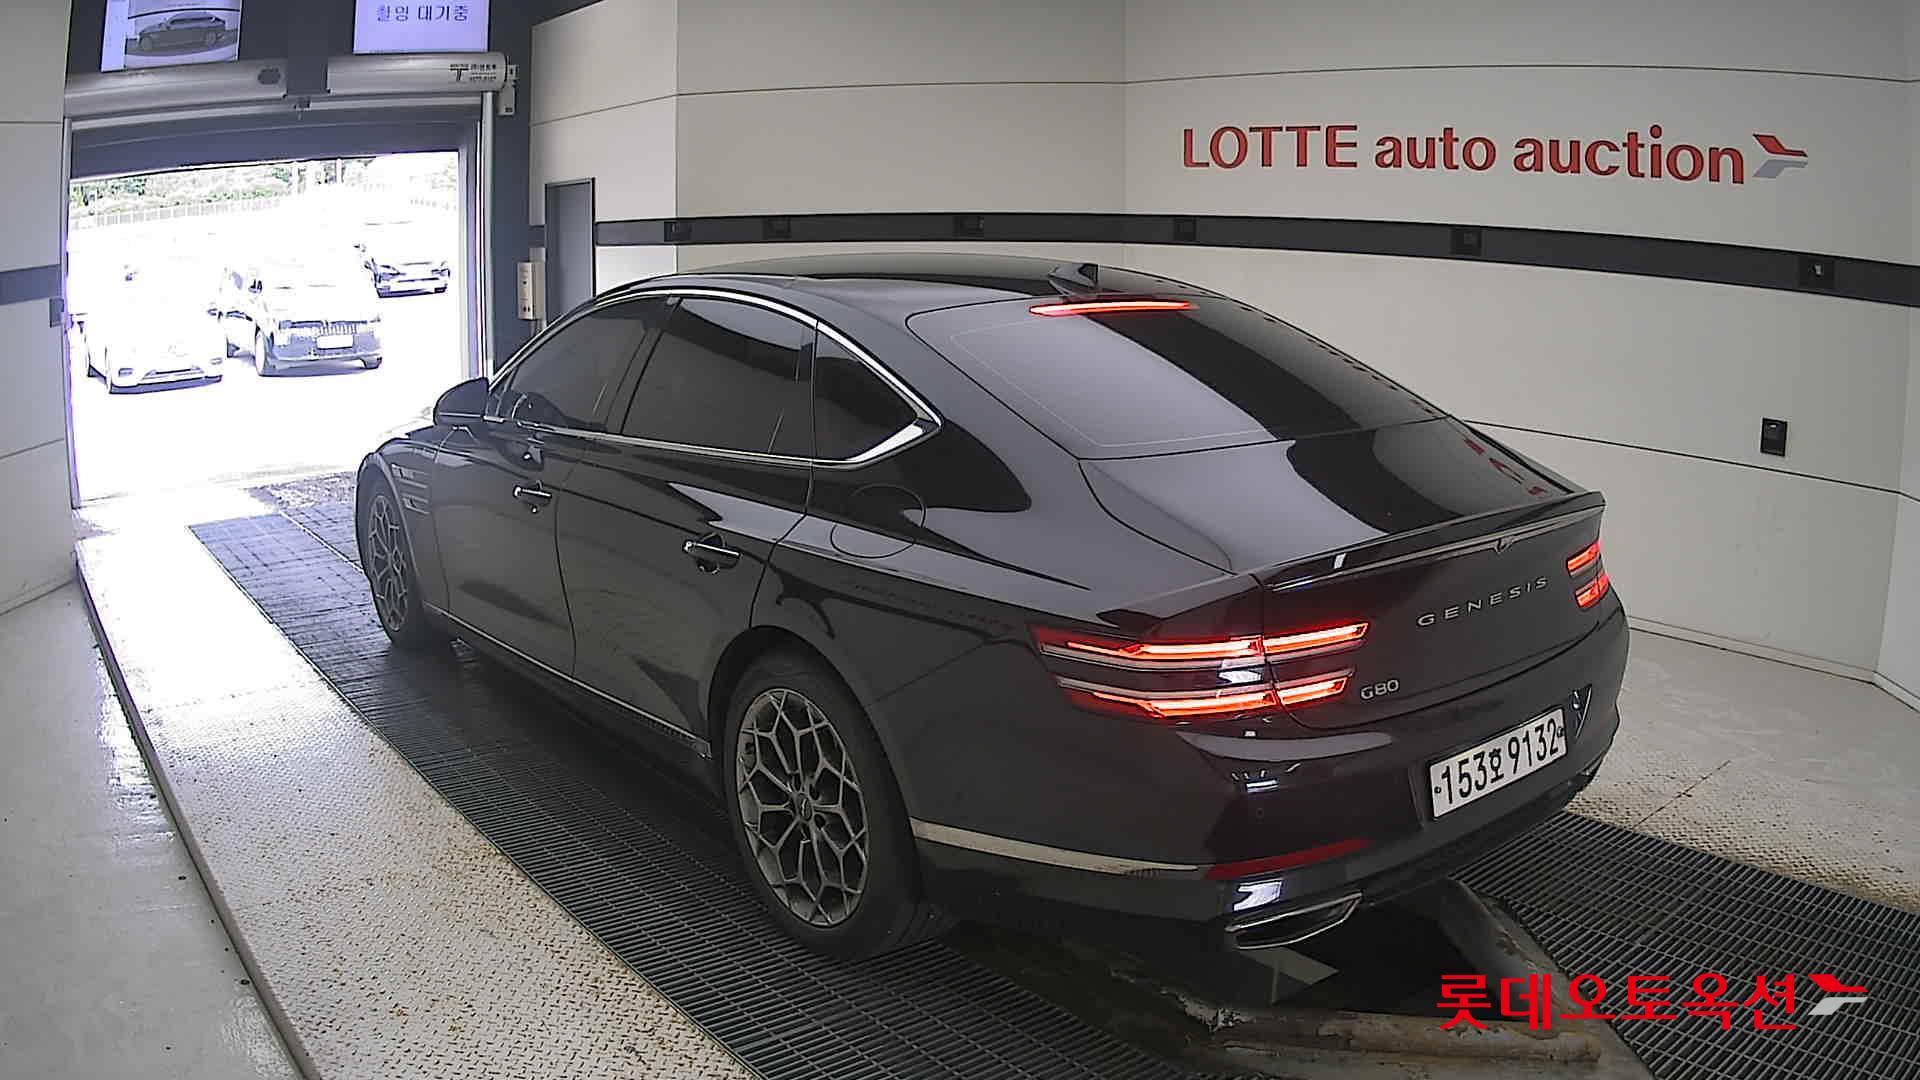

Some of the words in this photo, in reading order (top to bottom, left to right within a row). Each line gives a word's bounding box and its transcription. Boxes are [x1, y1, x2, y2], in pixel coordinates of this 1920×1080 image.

[417, 5, 470, 22] 대기중
[1183, 125, 1358, 169] LOTTE
[1375, 127, 1497, 170] auto
[1513, 124, 1745, 184] auction
[1416, 576, 1549, 627] GENESIS
[1360, 679, 1400, 700] G80
